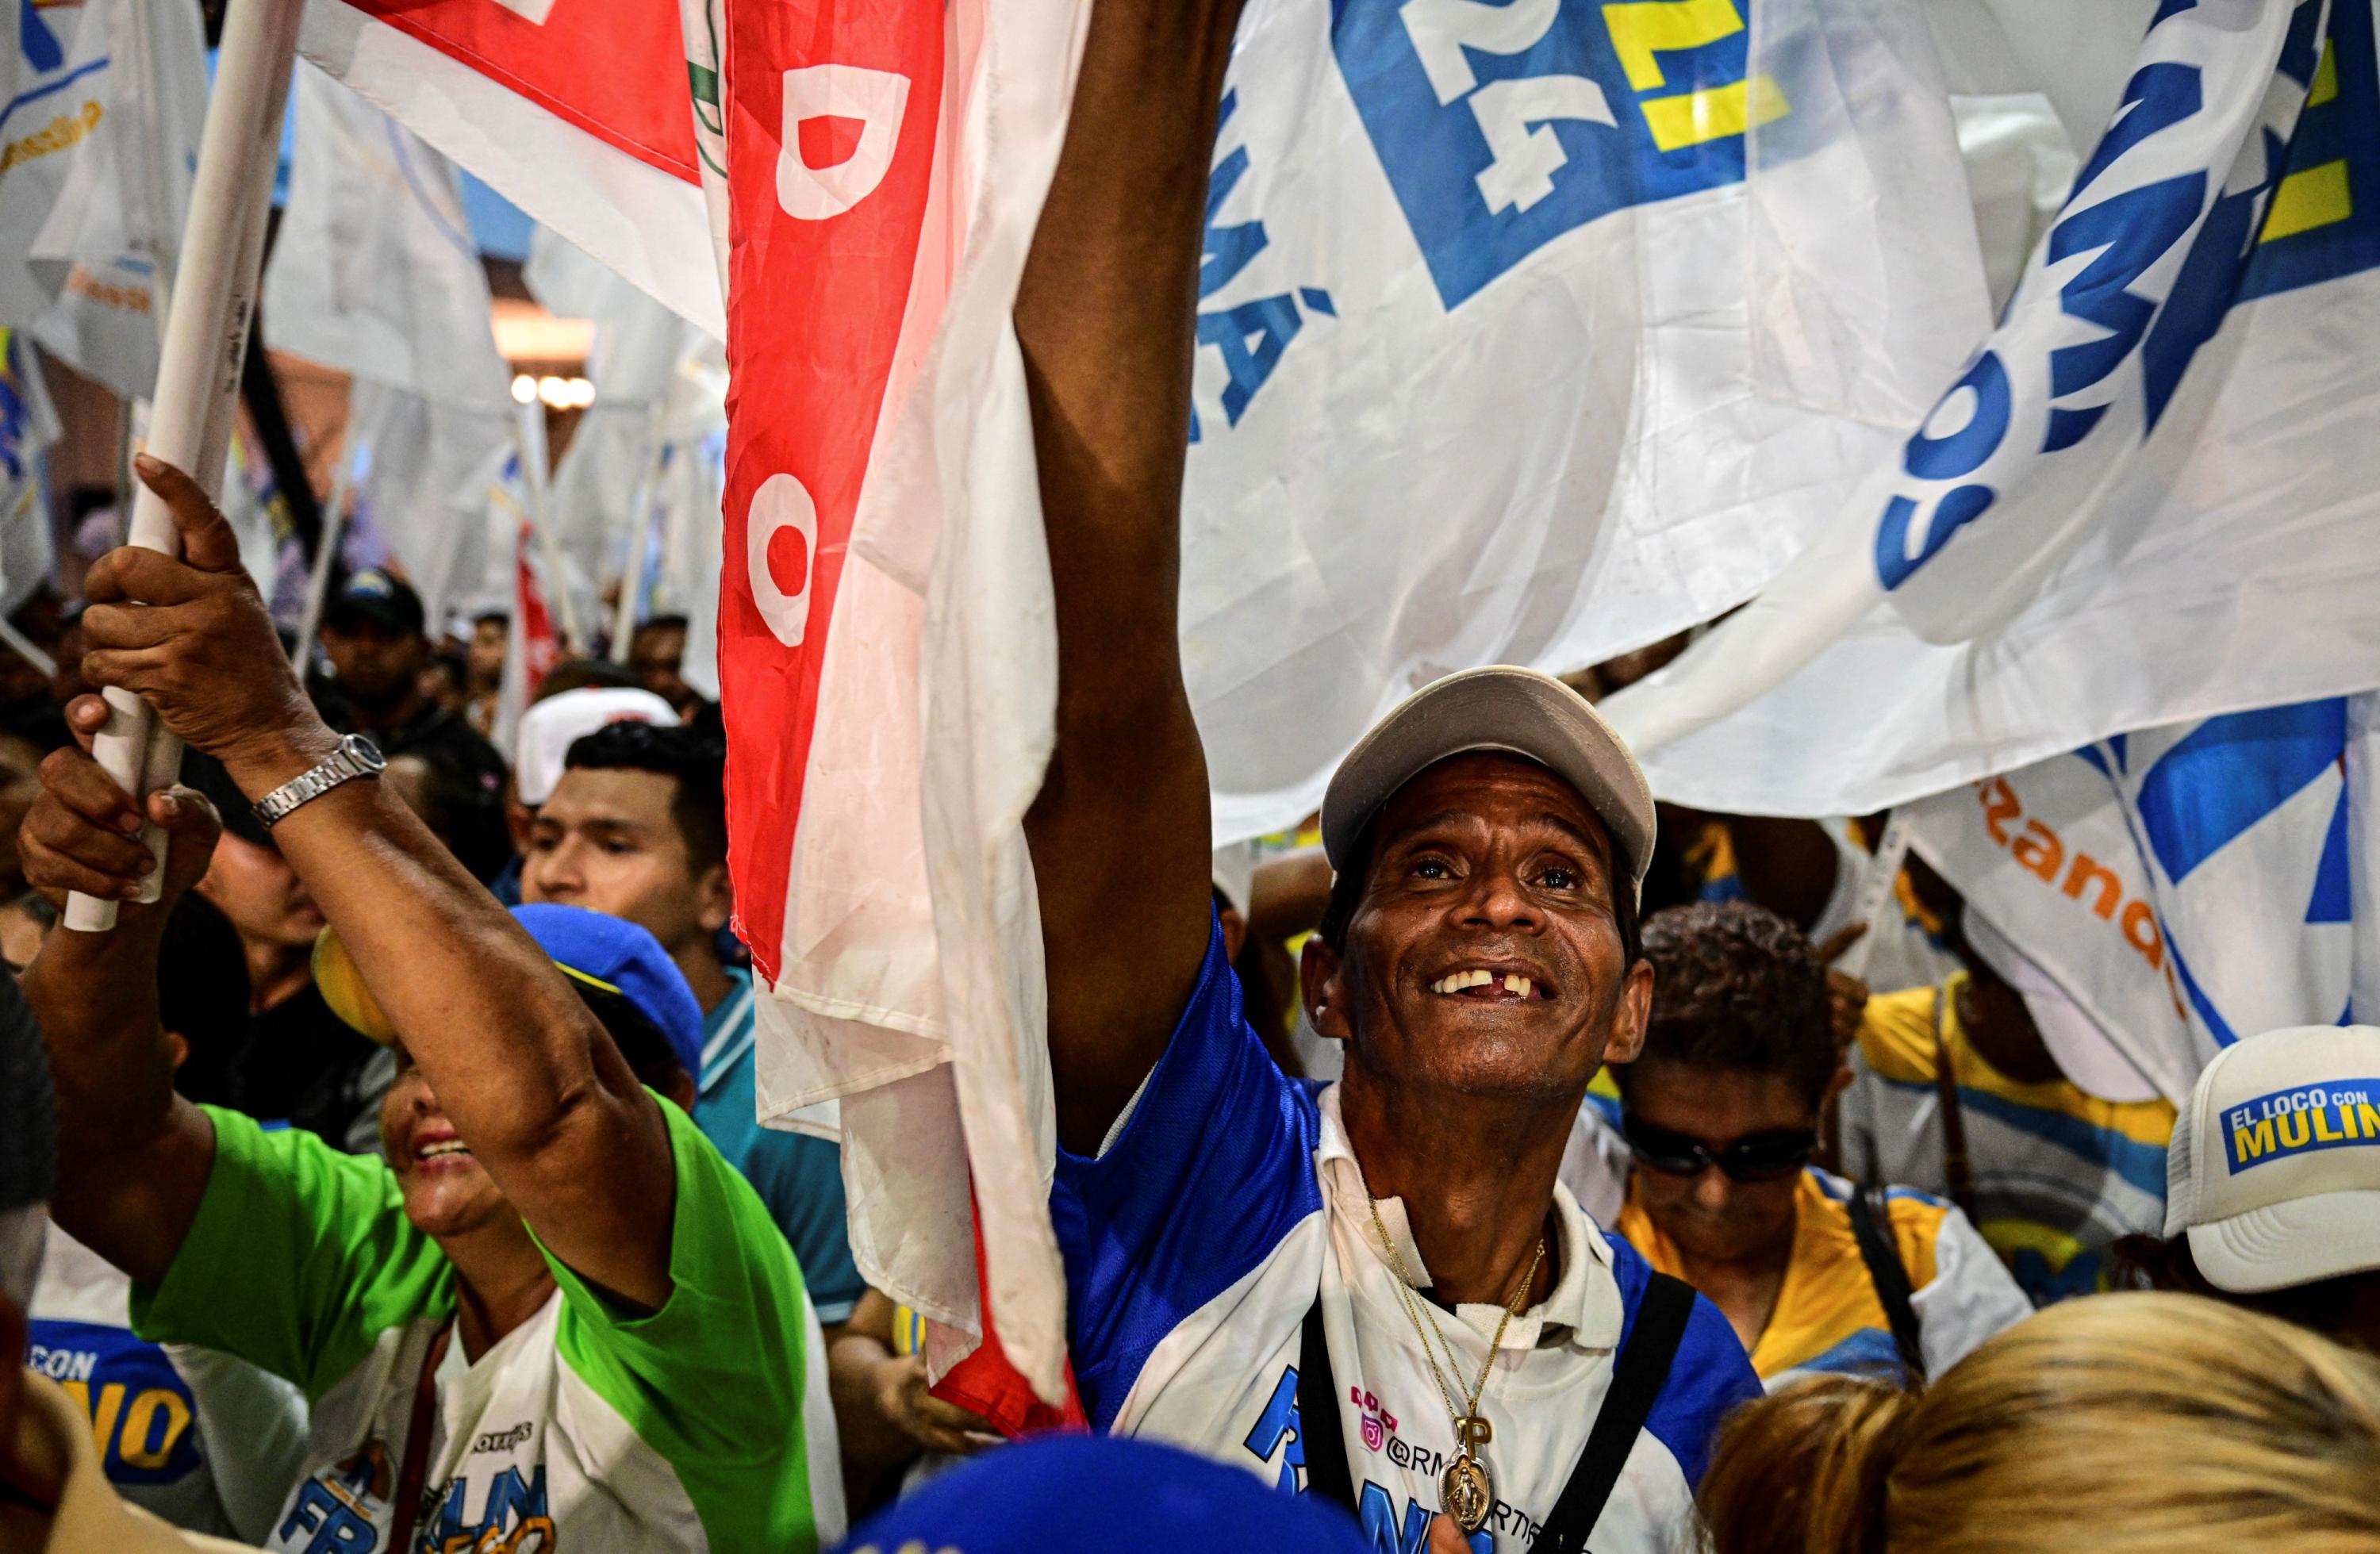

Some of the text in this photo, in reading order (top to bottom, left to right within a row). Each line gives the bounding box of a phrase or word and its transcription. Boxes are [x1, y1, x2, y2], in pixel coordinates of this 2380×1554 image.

[2230, 1088, 2369, 1131] EL LOCO CON
